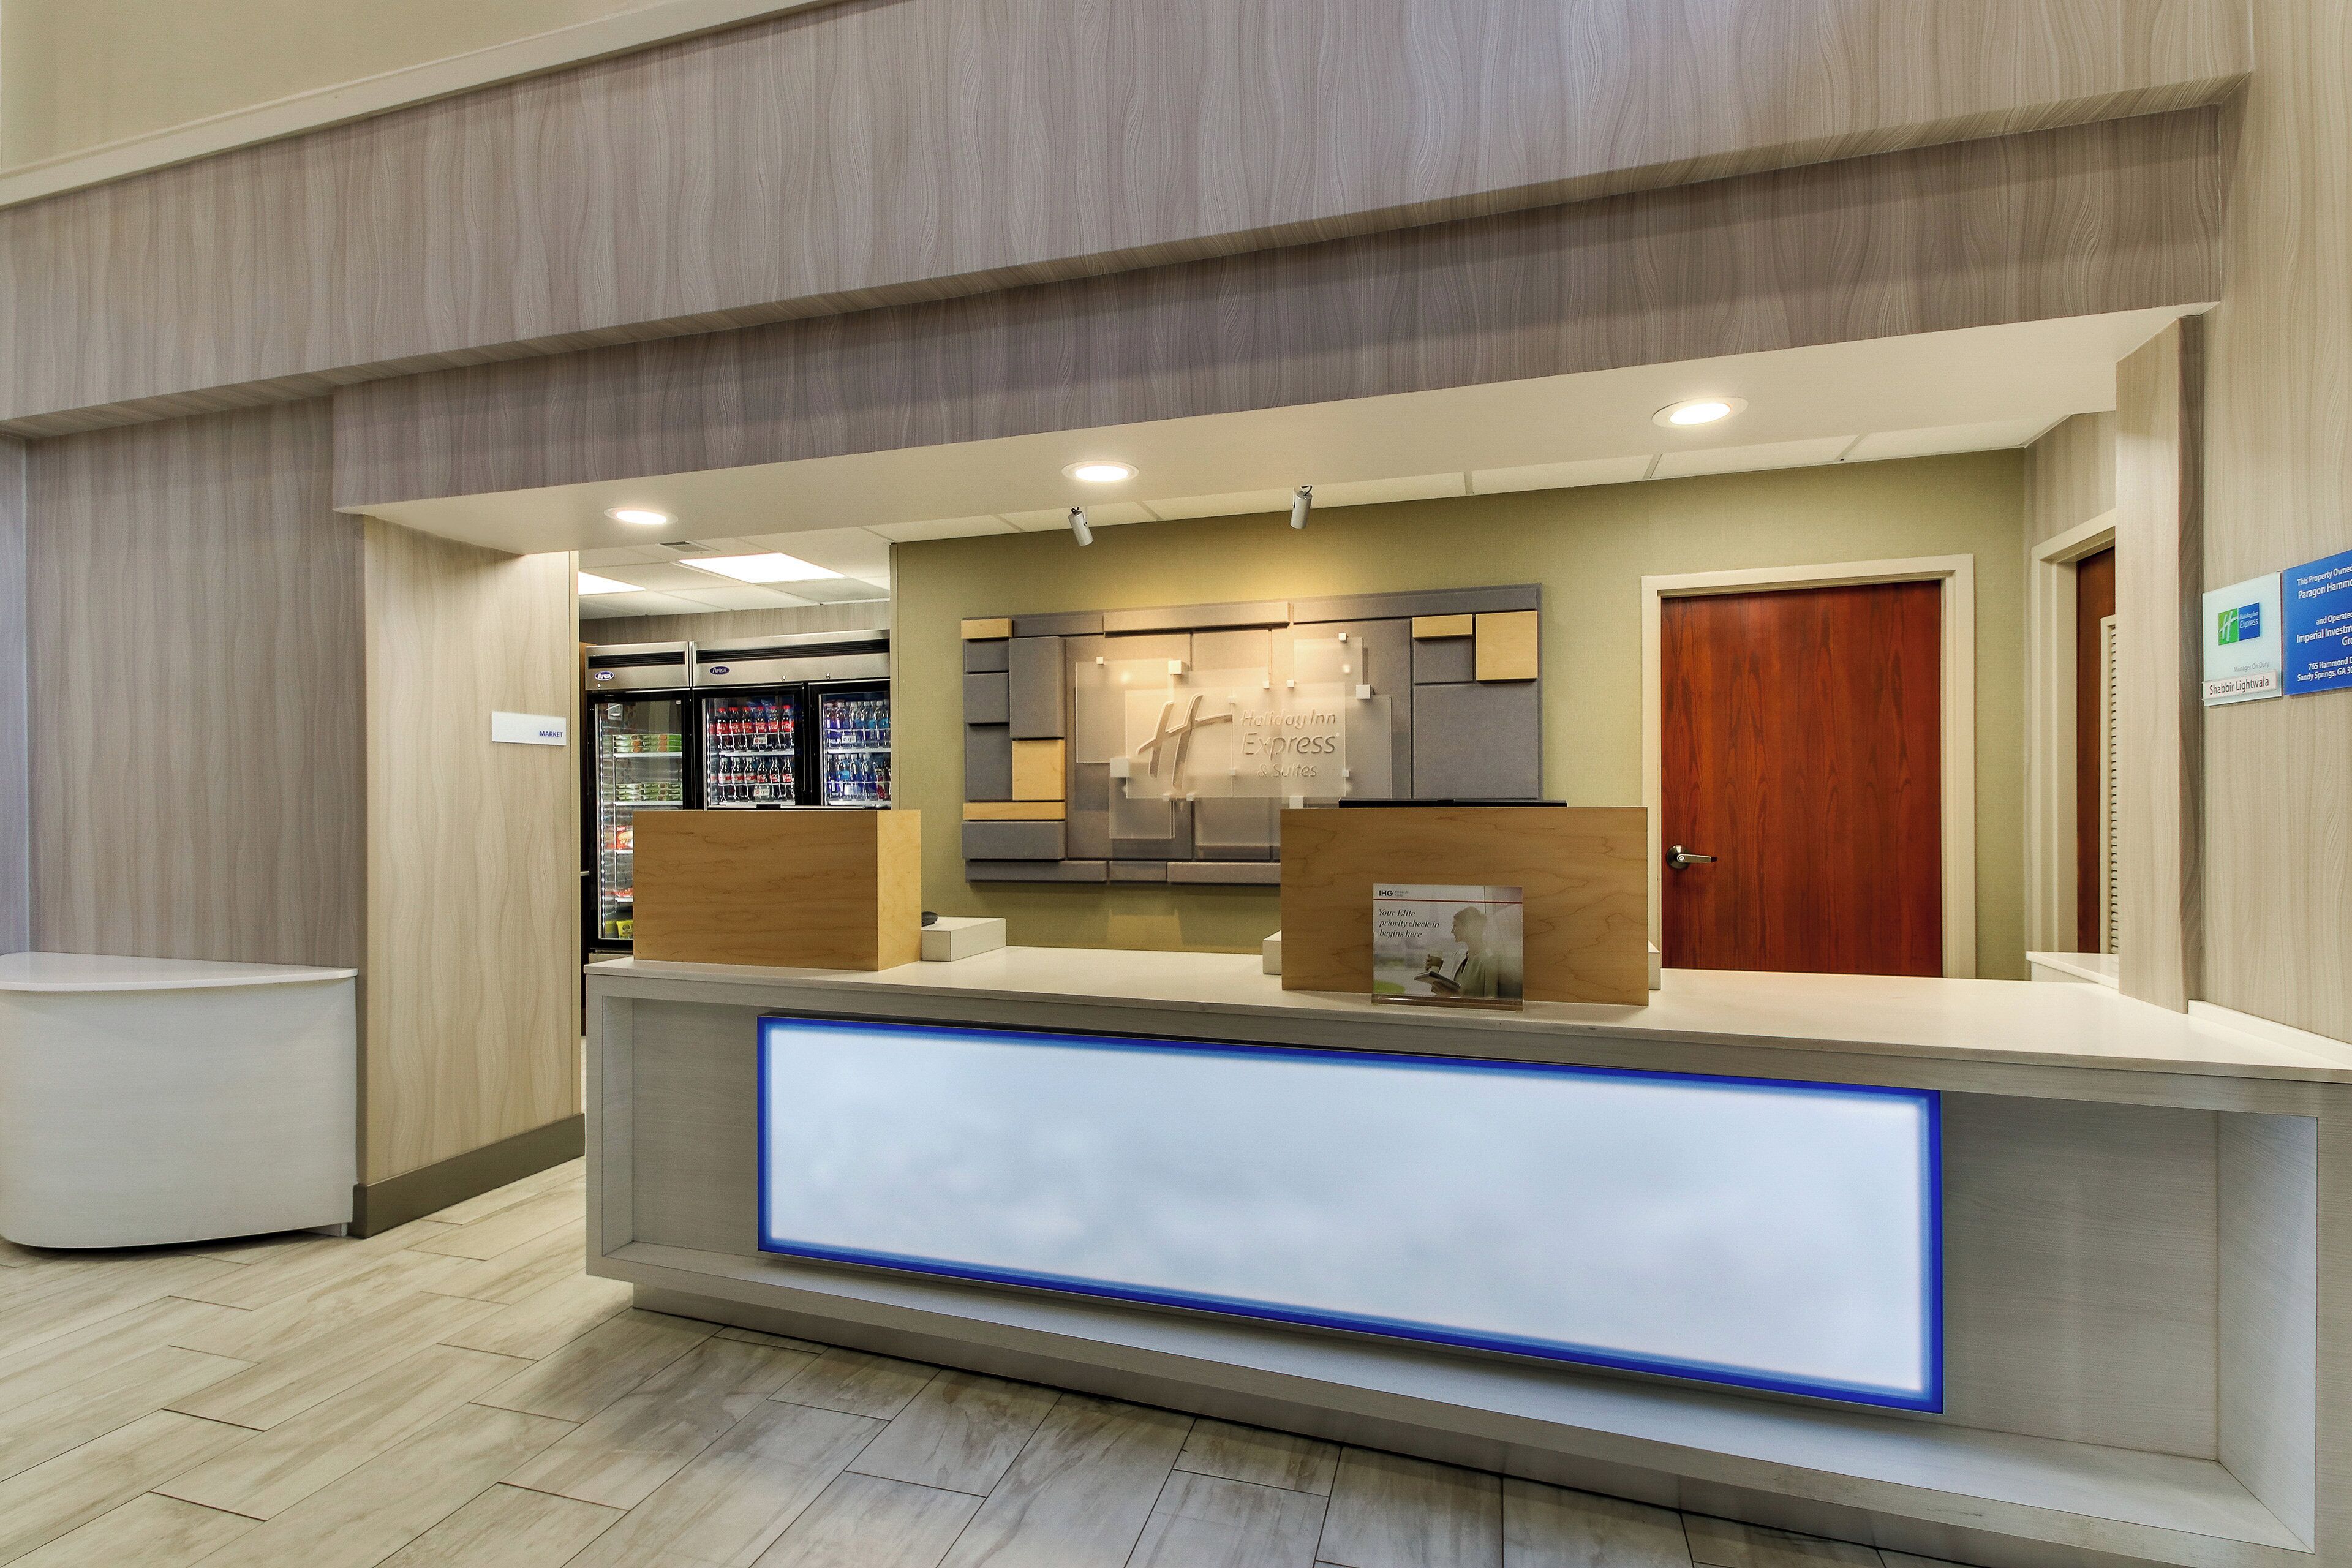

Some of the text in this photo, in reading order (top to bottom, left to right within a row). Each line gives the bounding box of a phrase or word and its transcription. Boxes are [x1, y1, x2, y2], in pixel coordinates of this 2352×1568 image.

[2297, 577, 2309, 586] This
[2309, 571, 2332, 583] Property
[2298, 586, 2326, 600] Paragon
[2239, 618, 2258, 629] Express
[2316, 616, 2327, 625] and
[2296, 628, 2324, 644] Imperial
[2234, 664, 2252, 673] Manager
[2319, 657, 2348, 669] Hammond
[2297, 673, 2313, 682] Sandy
[2314, 670, 2336, 680] Springs,
[2337, 667, 2346, 676] GA
[2209, 676, 2269, 695] Shabbir Lightwala
[1240, 708, 1336, 730] Holiday Inn
[1241, 731, 1336, 762] Express
[1272, 762, 1317, 778] Suites
[1379, 919, 1408, 929] priority
[1379, 929, 1404, 938] begins
